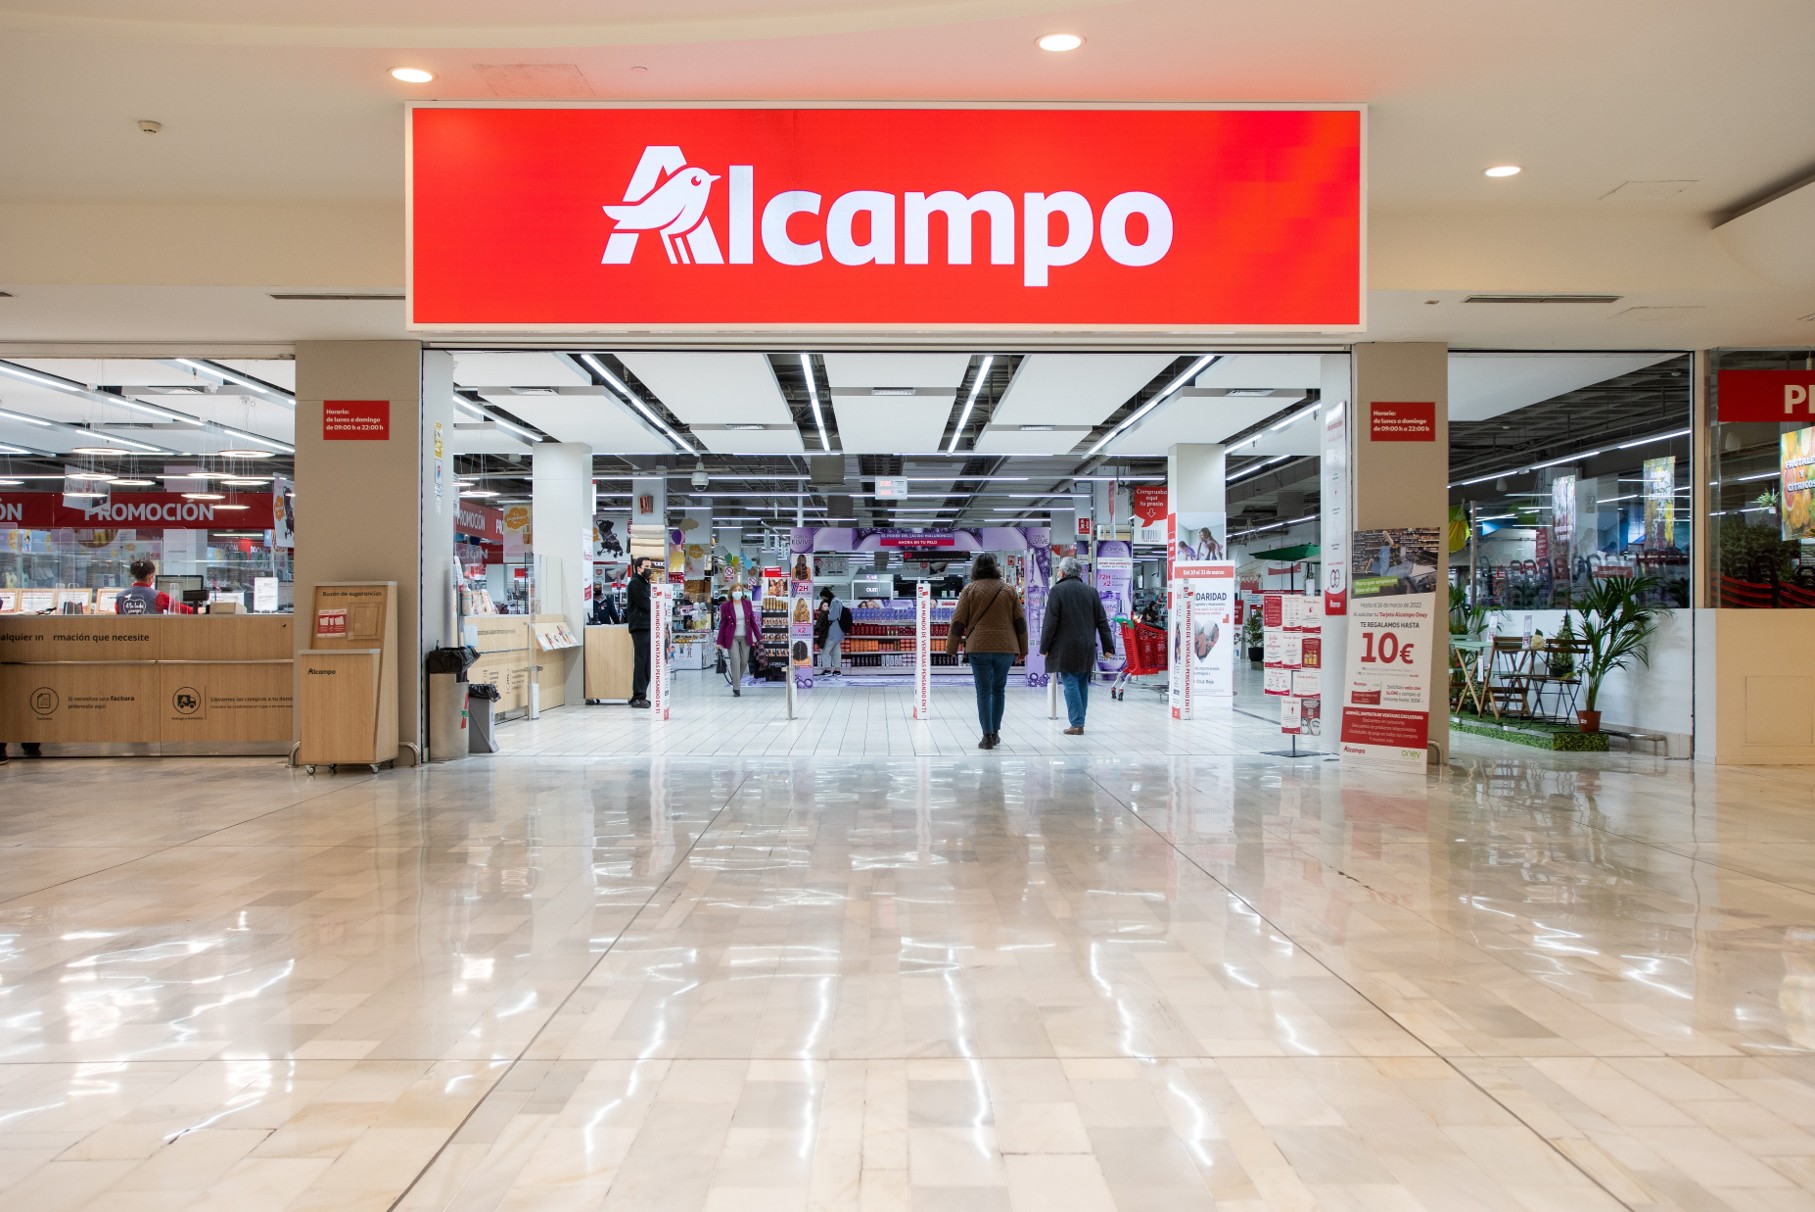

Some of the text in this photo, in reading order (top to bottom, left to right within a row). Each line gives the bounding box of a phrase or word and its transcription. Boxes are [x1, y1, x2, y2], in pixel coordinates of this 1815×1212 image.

[601, 146, 1174, 286] Alcampo
[656, 601, 660, 610] UN
[922, 601, 926, 610] UN
[1186, 601, 1191, 609] UN
[93, 634, 109, 644] que
[112, 633, 150, 642] necesite
[1361, 632, 1414, 664] 10€
[1344, 745, 1421, 759] Alcampo oney
